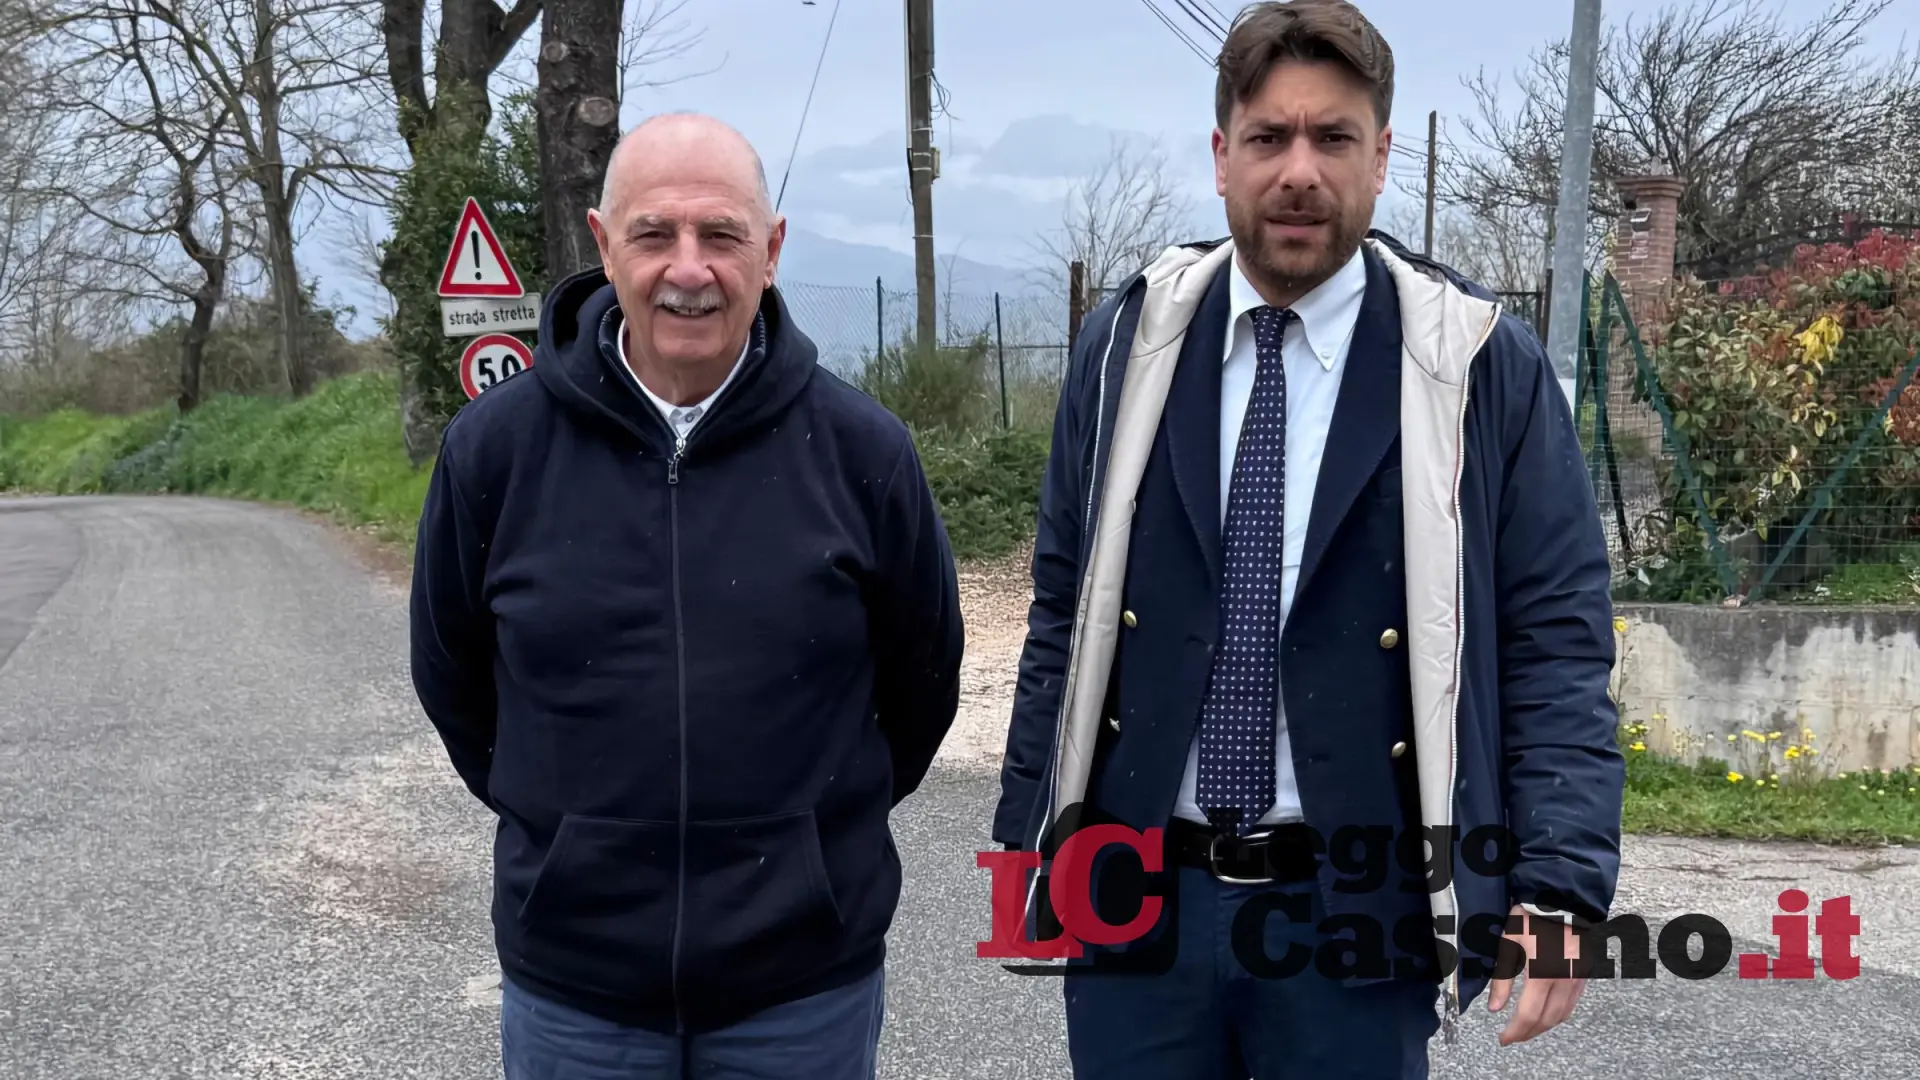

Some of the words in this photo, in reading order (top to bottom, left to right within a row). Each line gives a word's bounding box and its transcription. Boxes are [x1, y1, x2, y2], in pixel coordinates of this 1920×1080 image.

[449, 309, 487, 326] strada
[492, 304, 536, 323] stretta
[478, 354, 522, 389] 50
